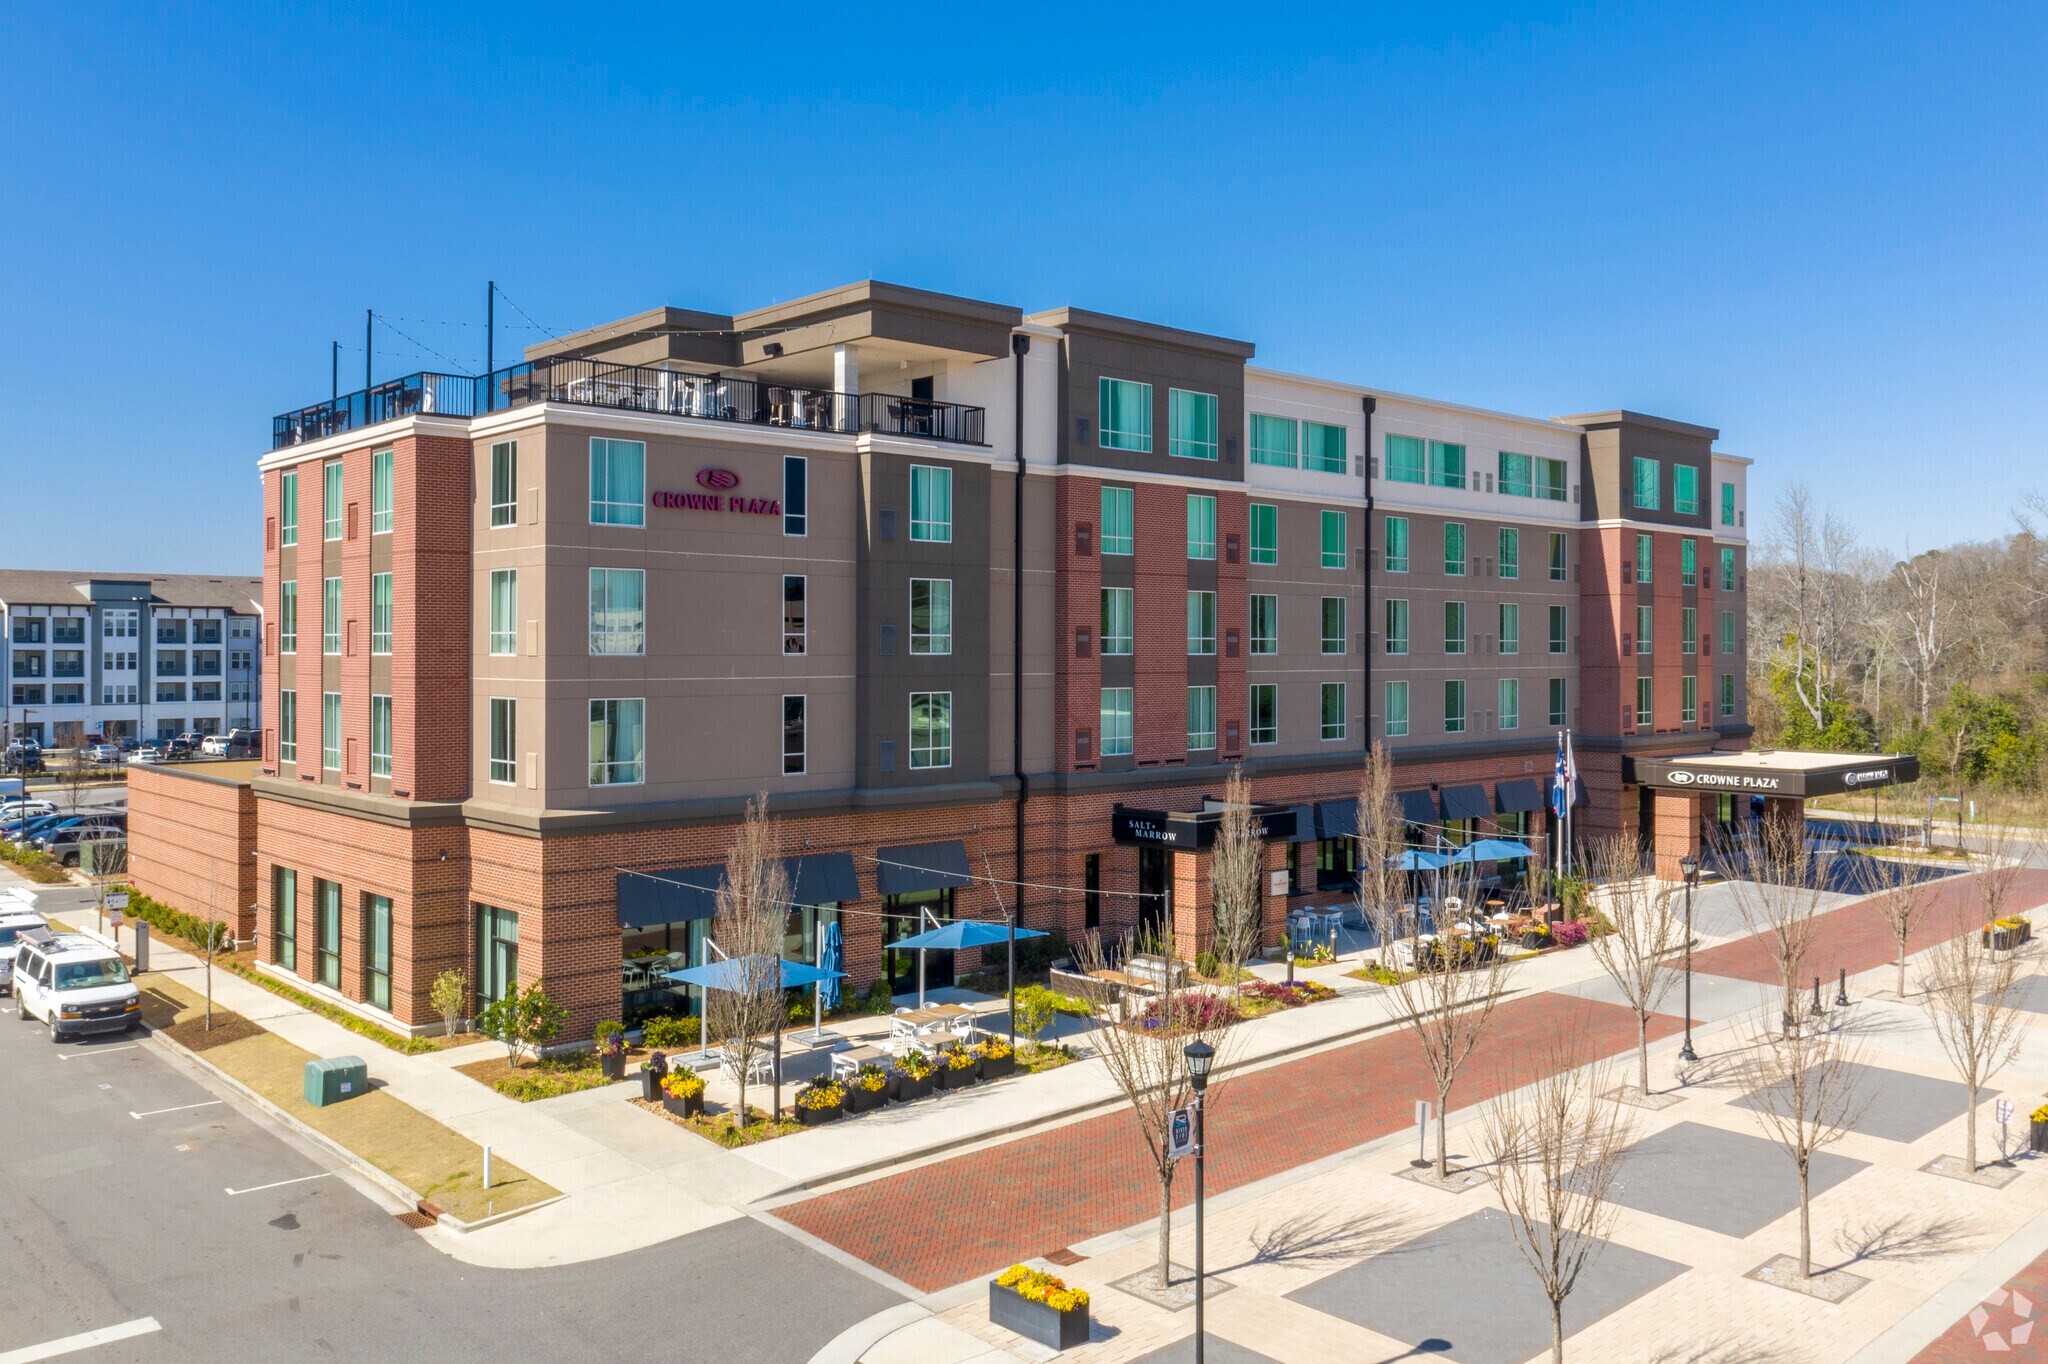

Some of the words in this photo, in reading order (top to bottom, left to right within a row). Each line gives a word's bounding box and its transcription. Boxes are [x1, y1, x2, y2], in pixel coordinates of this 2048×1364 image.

[652, 491, 725, 511] CROWNE
[730, 496, 781, 515] PLAZA
[1696, 774, 1740, 786] CROWNE
[1743, 777, 1778, 788] PLAZA
[1135, 829, 1177, 841] MARROW
